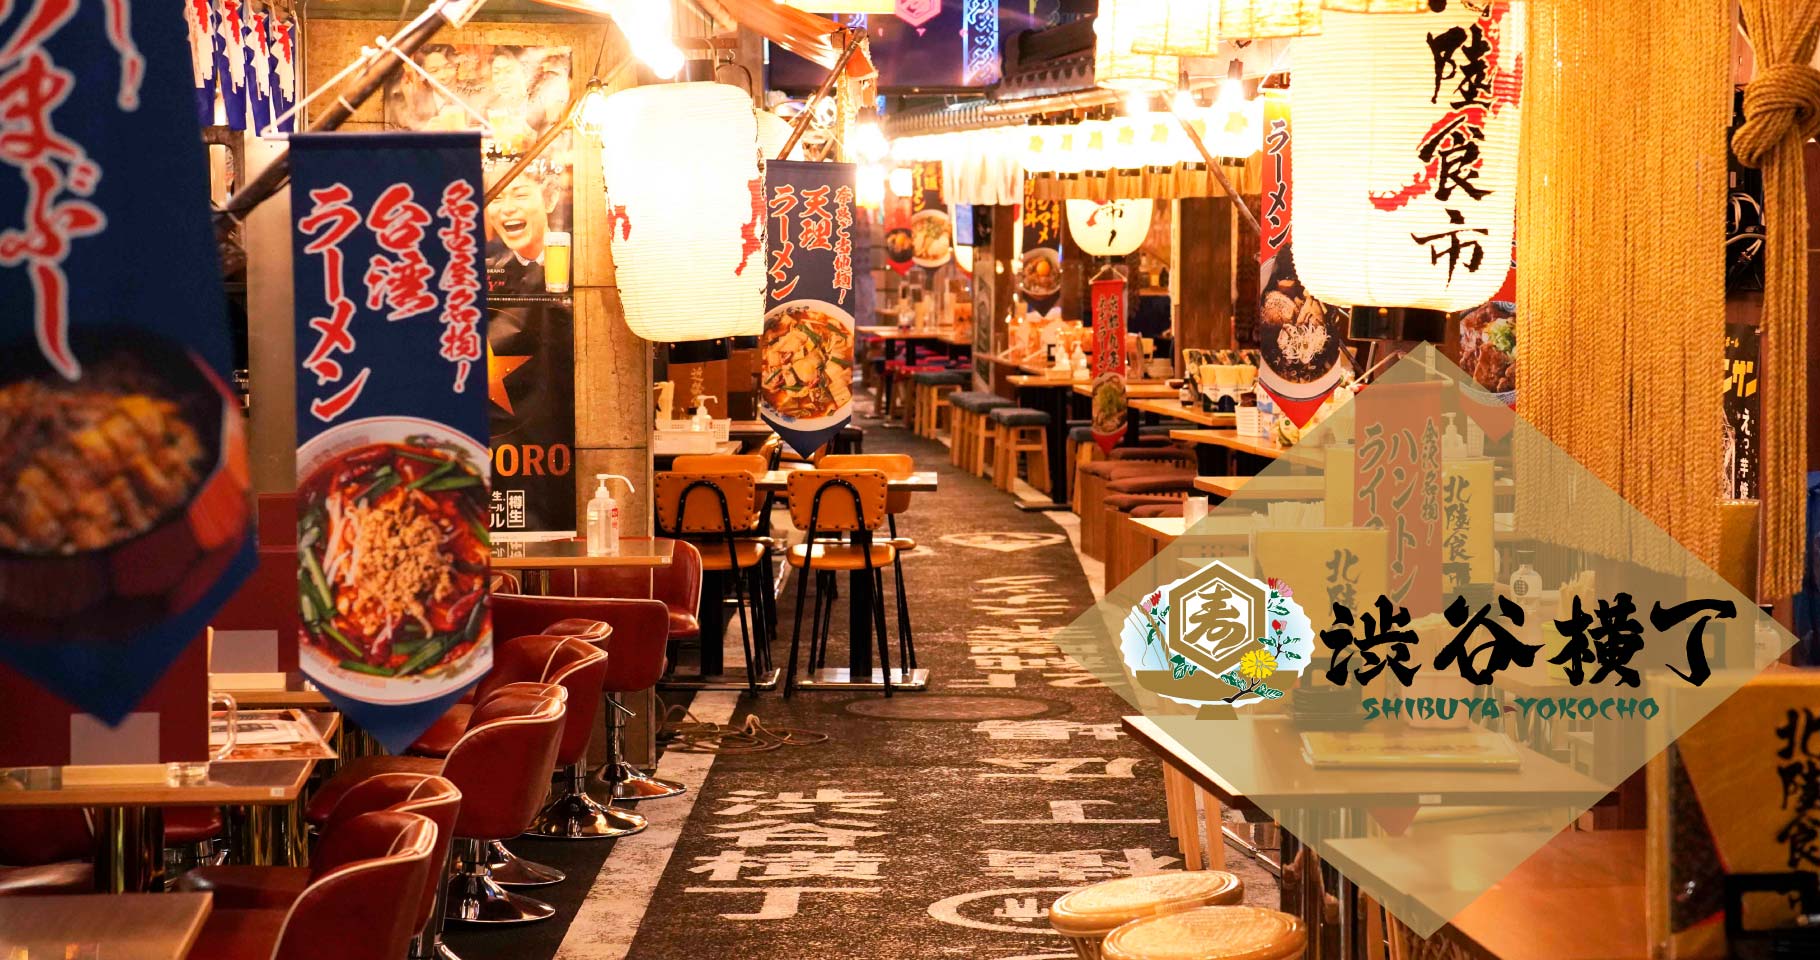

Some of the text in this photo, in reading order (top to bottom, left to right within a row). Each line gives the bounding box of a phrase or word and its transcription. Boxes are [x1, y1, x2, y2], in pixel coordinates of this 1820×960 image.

[768, 183, 800, 301] ラーメン
[798, 184, 834, 252] 天理
[1265, 119, 1292, 249] ラーメン
[297, 182, 372, 423] ラーメン
[366, 182, 439, 322] 台湾
[488, 443, 571, 477] ORO
[508, 495, 523, 524] 樽生
[1387, 428, 1419, 603] ハントン
[684, 788, 898, 920] 渋谷横丁
